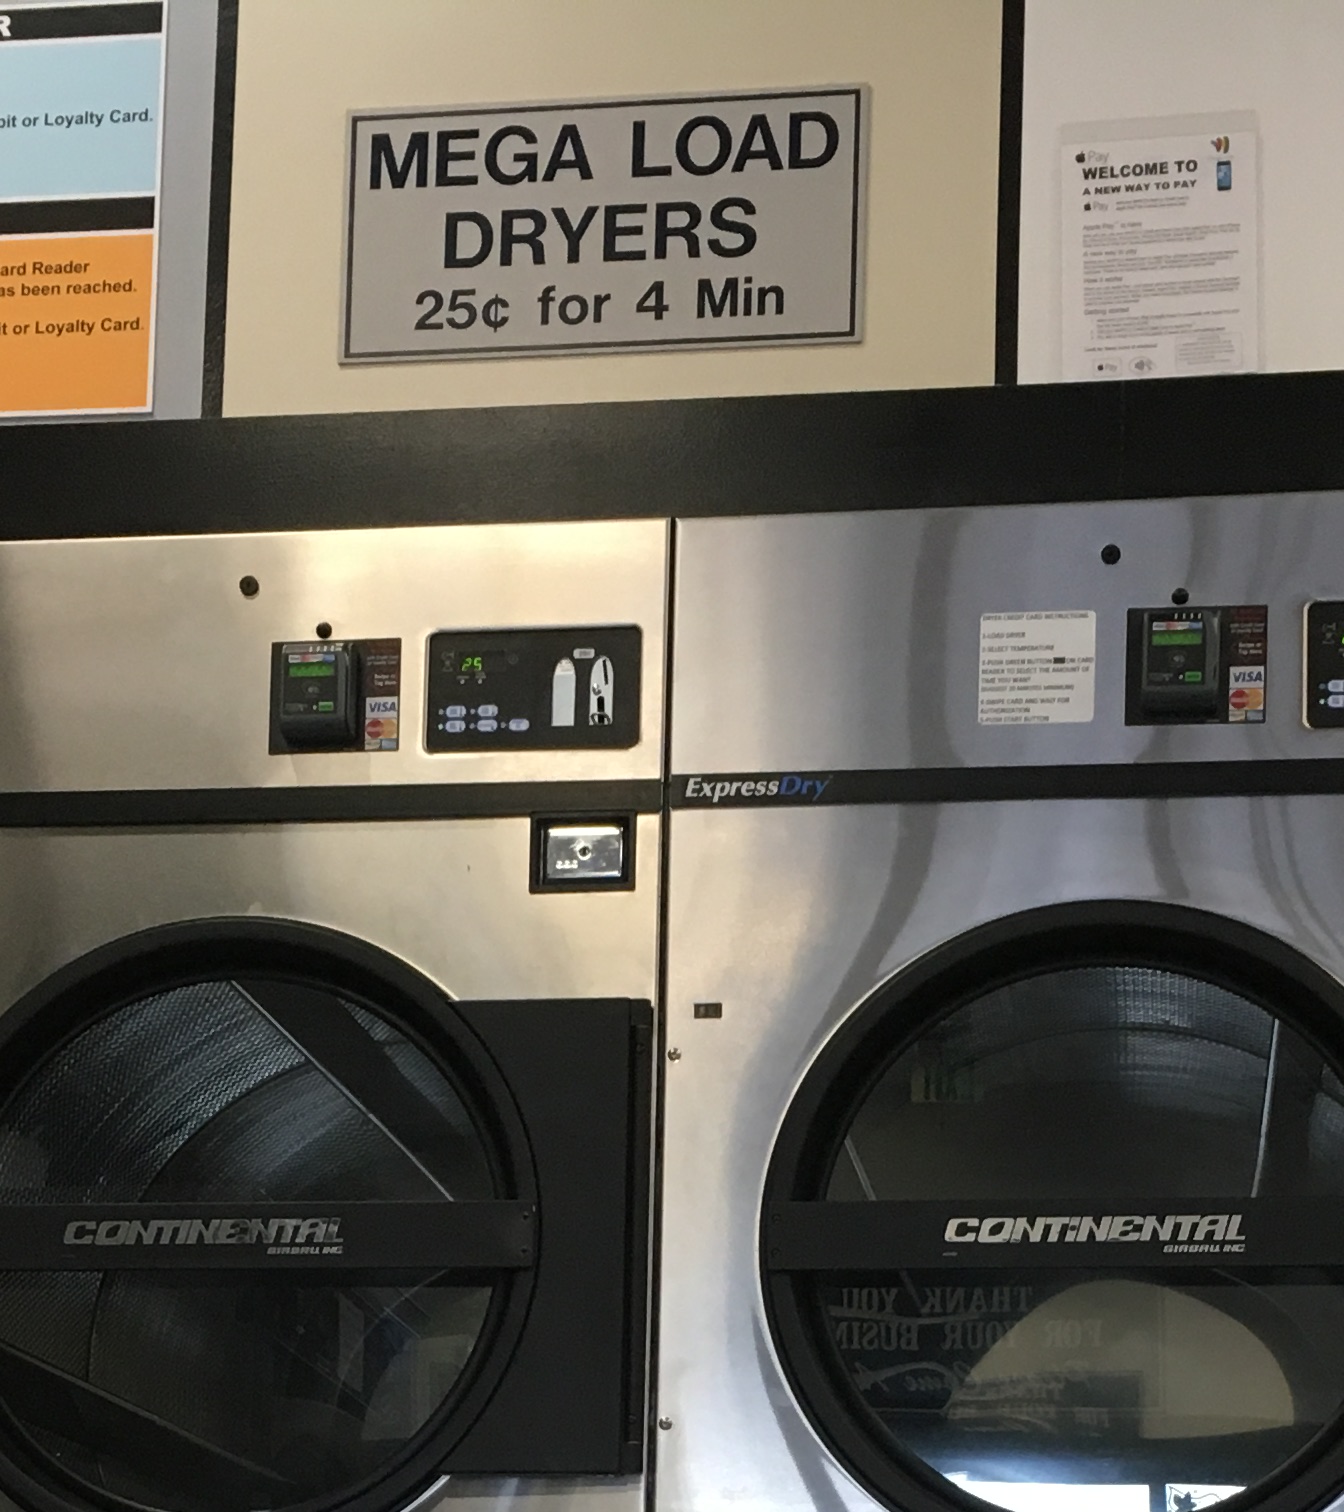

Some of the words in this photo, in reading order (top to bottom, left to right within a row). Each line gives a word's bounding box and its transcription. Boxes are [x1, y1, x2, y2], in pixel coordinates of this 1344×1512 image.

[22, 116, 39, 128] or
[44, 110, 105, 129] Loyalty
[109, 108, 153, 124] Card.
[368, 122, 594, 191] MEGA
[630, 110, 840, 178] LOAD
[1082, 161, 1169, 181] WELCOME
[1174, 159, 1199, 174] TO
[1082, 187, 1091, 196] A
[1095, 184, 1122, 195] NEW
[1125, 183, 1150, 193] WAY
[1155, 181, 1171, 191] TO
[1174, 179, 1198, 189] PAY
[443, 196, 758, 270] DRYERS
[32, 260, 90, 276] Reader
[20, 280, 61, 296] been
[66, 278, 138, 295] reached.
[413, 287, 511, 333] 25¢
[539, 285, 612, 327] for
[635, 280, 670, 321] 4
[696, 275, 786, 320] Min
[13, 321, 30, 334] or
[34, 316, 95, 337] Loyalty
[100, 315, 144, 333] Card.
[1233, 671, 1263, 682] VISA
[369, 702, 396, 712] VISA
[685, 775, 832, 802] ExpressDry
[63, 1218, 344, 1245] CONTINENTAL
[944, 1214, 1246, 1244] CONTINENTAL
[1223, 1243, 1245, 1252] INC
